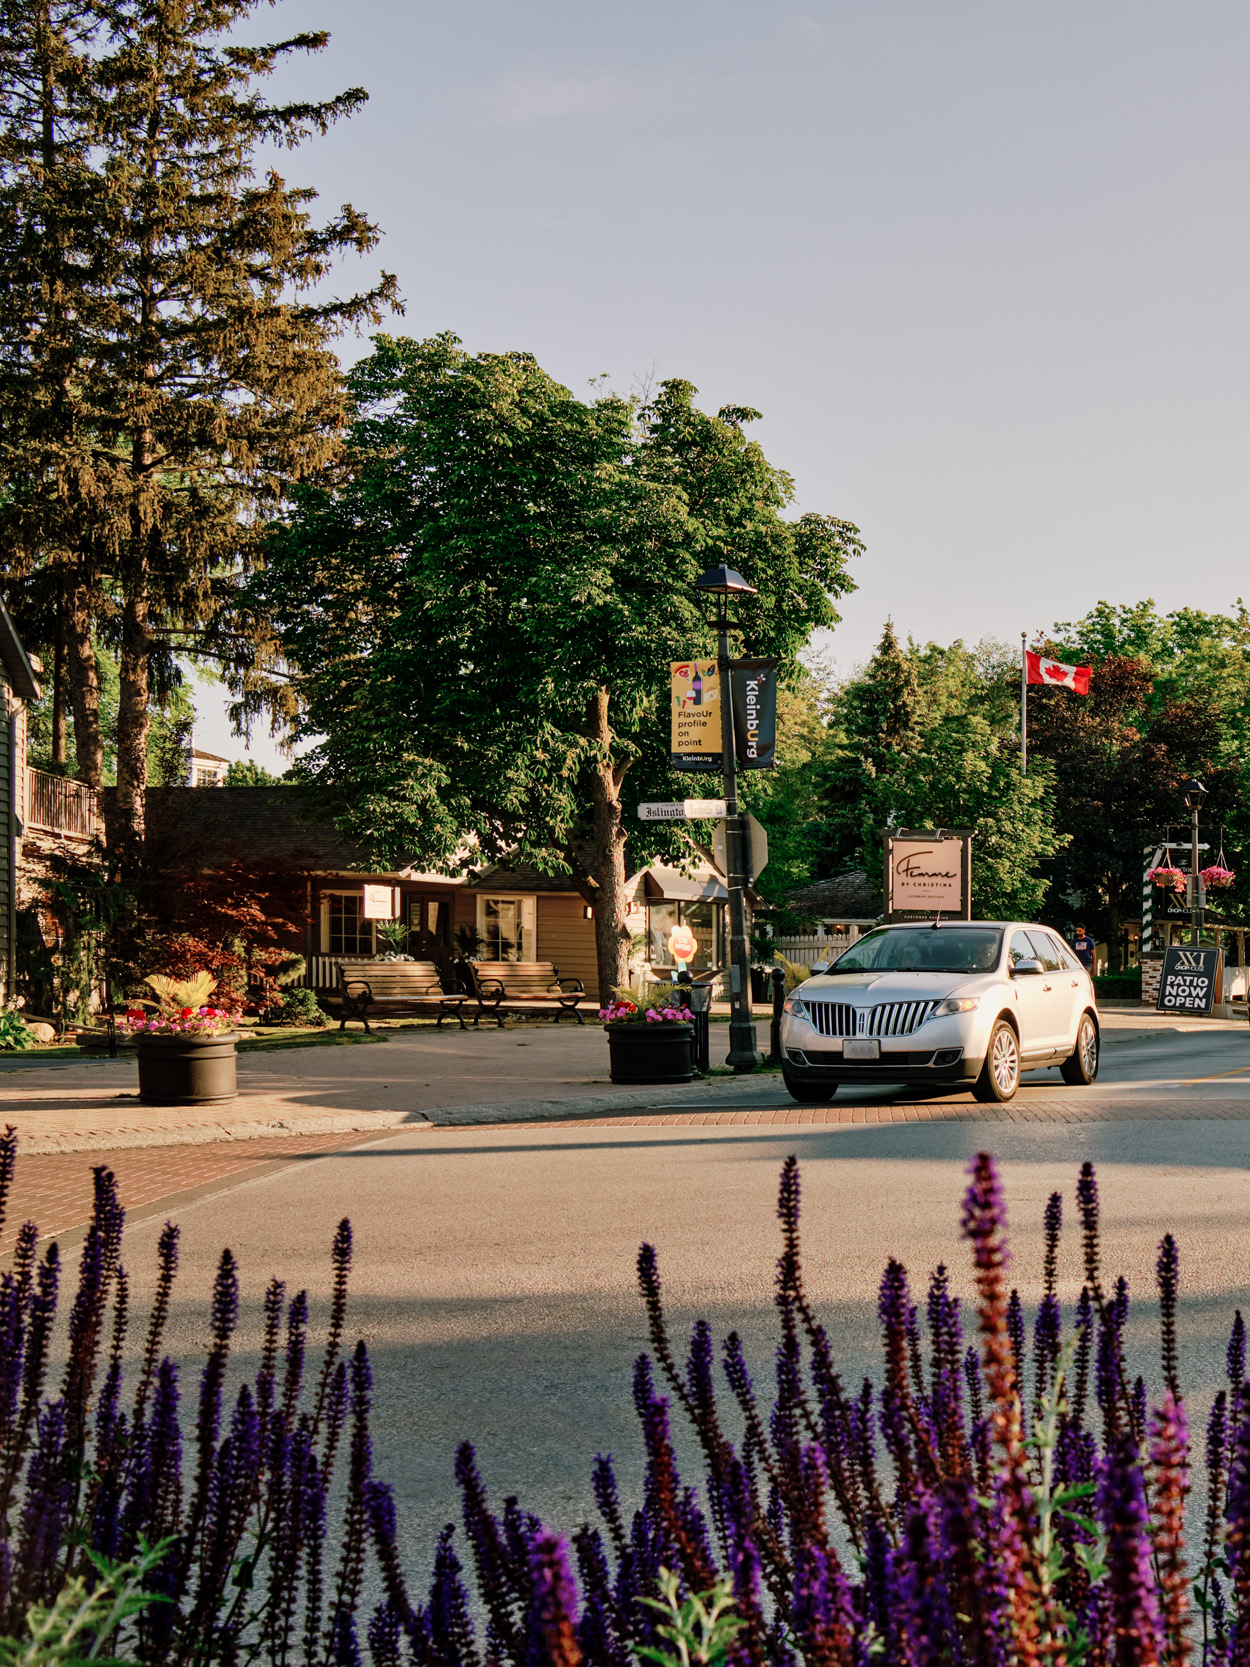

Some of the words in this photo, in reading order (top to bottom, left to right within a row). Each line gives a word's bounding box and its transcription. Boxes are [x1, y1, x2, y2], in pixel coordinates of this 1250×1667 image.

[678, 720, 707, 729] profile
[678, 739, 702, 747] point
[645, 807, 686, 818] Islingto
[896, 851, 957, 878] Femme
[1176, 951, 1206, 966] XXI
[1167, 975, 1209, 987] PATIO
[1165, 985, 1207, 998] NOW
[1164, 996, 1206, 1008] OPEN
